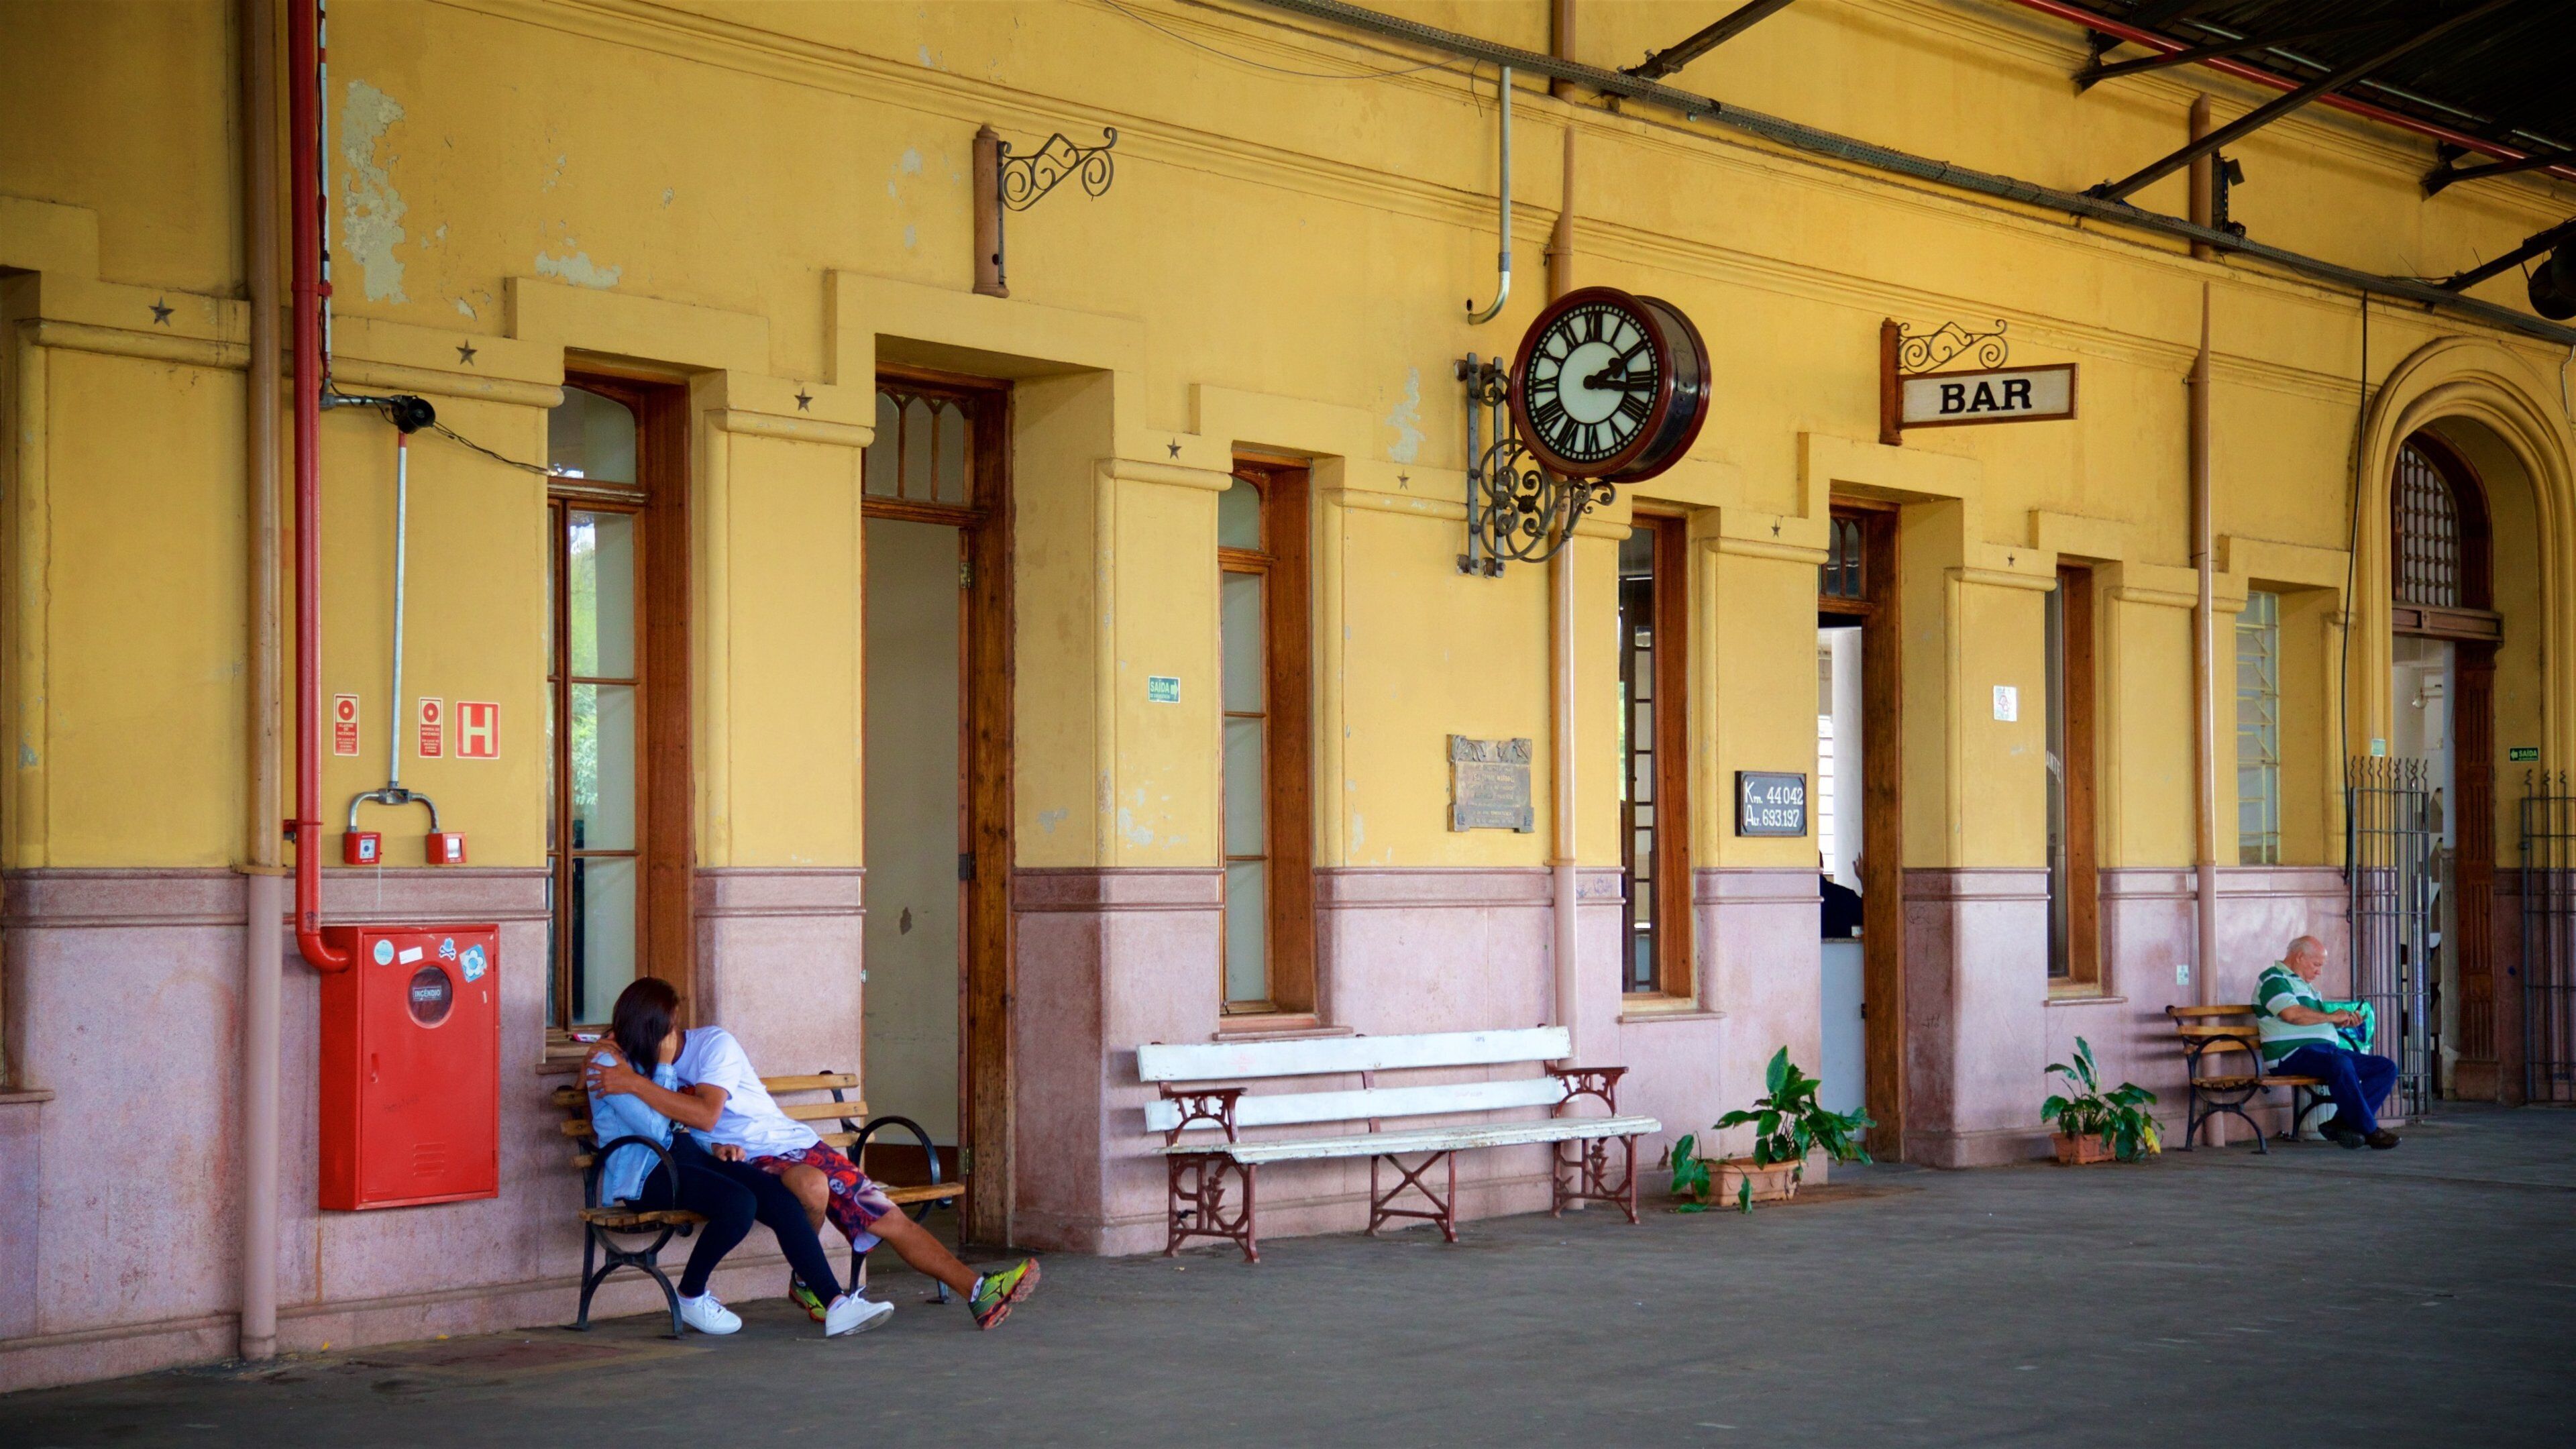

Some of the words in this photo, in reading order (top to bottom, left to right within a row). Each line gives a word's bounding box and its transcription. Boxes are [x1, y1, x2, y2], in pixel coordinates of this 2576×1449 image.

[1939, 379, 2032, 415] BAR
[1150, 680, 1170, 694] SAÍDA
[463, 706, 493, 754] H
[2518, 749, 2537, 757] SAÍDA
